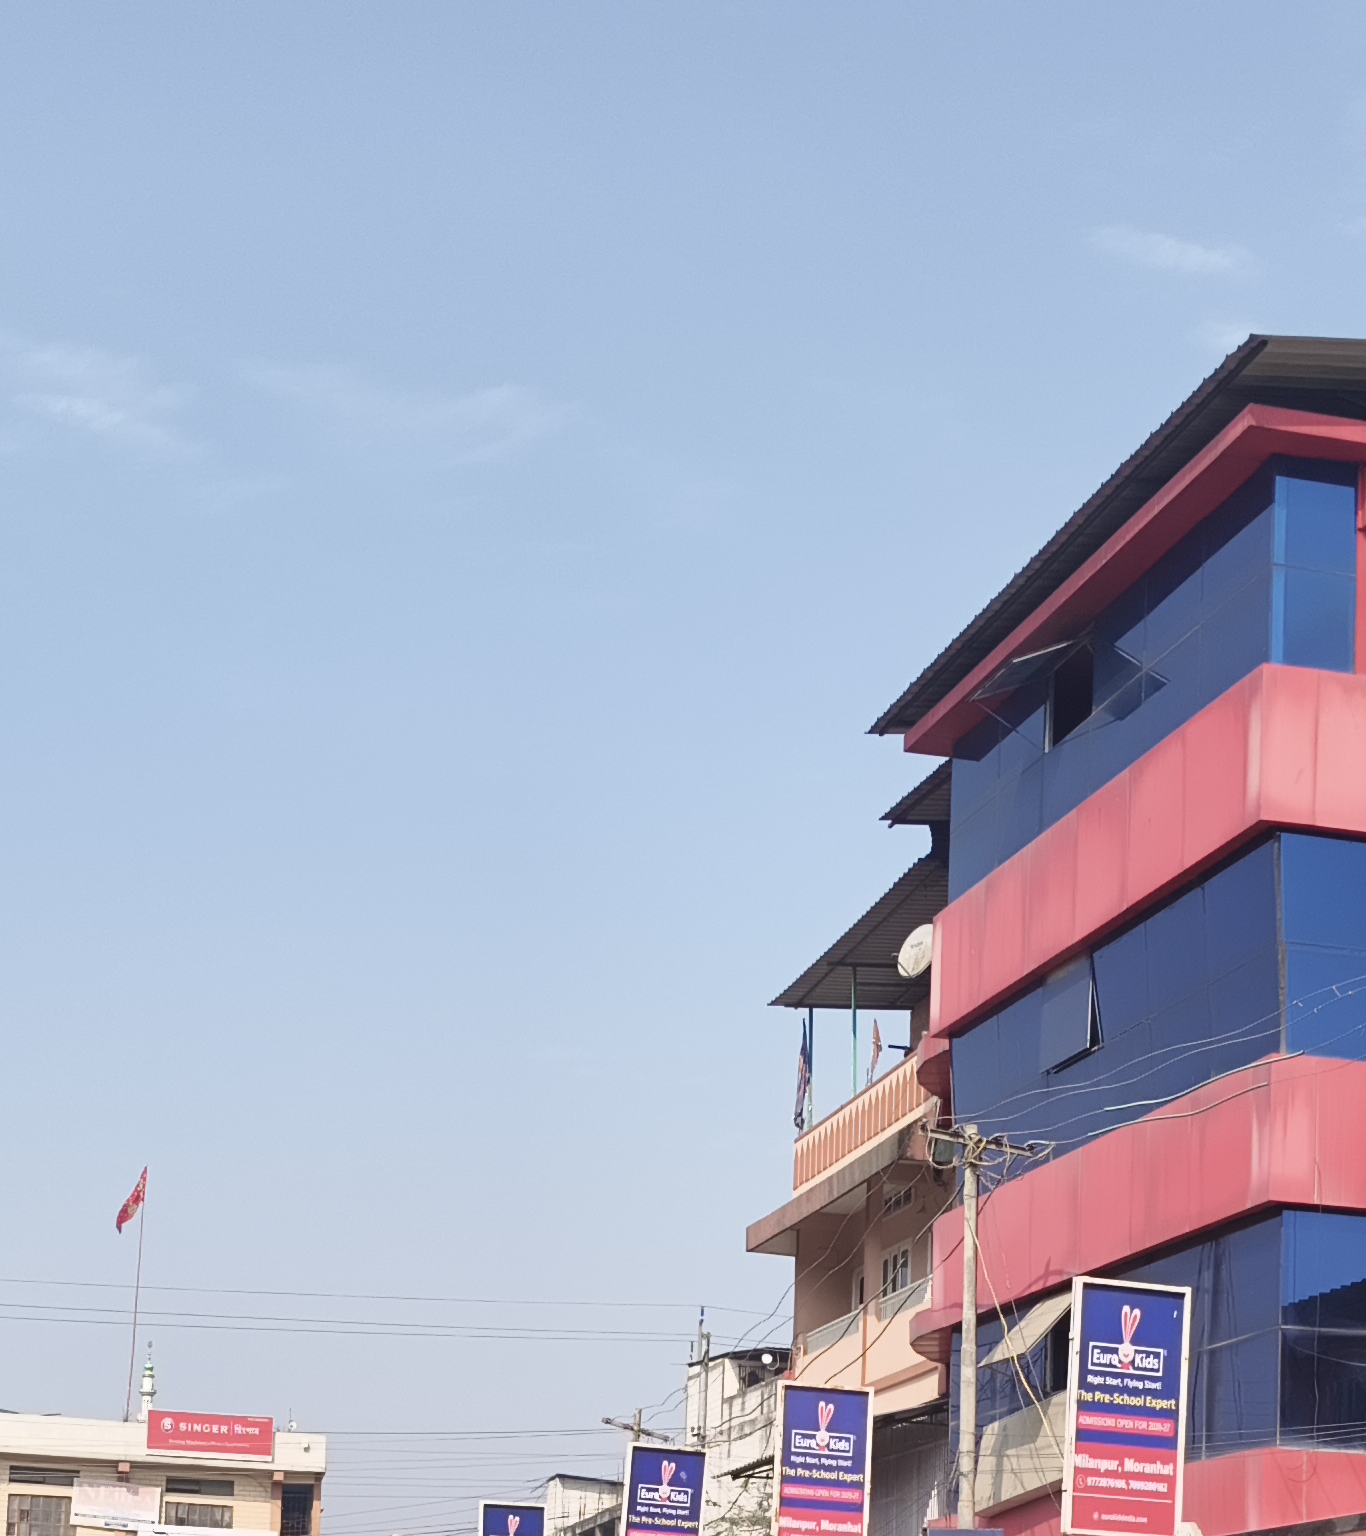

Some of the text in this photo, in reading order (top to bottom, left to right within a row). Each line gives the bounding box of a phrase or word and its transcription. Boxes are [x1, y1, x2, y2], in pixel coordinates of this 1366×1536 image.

[1093, 1349, 1159, 1369] Euro Kids
[1077, 1389, 1176, 1410] The Pre-School Expert
[179, 1422, 228, 1435] SINGER
[829, 1436, 850, 1451] Kids
[1124, 1457, 1174, 1476] Moranhat
